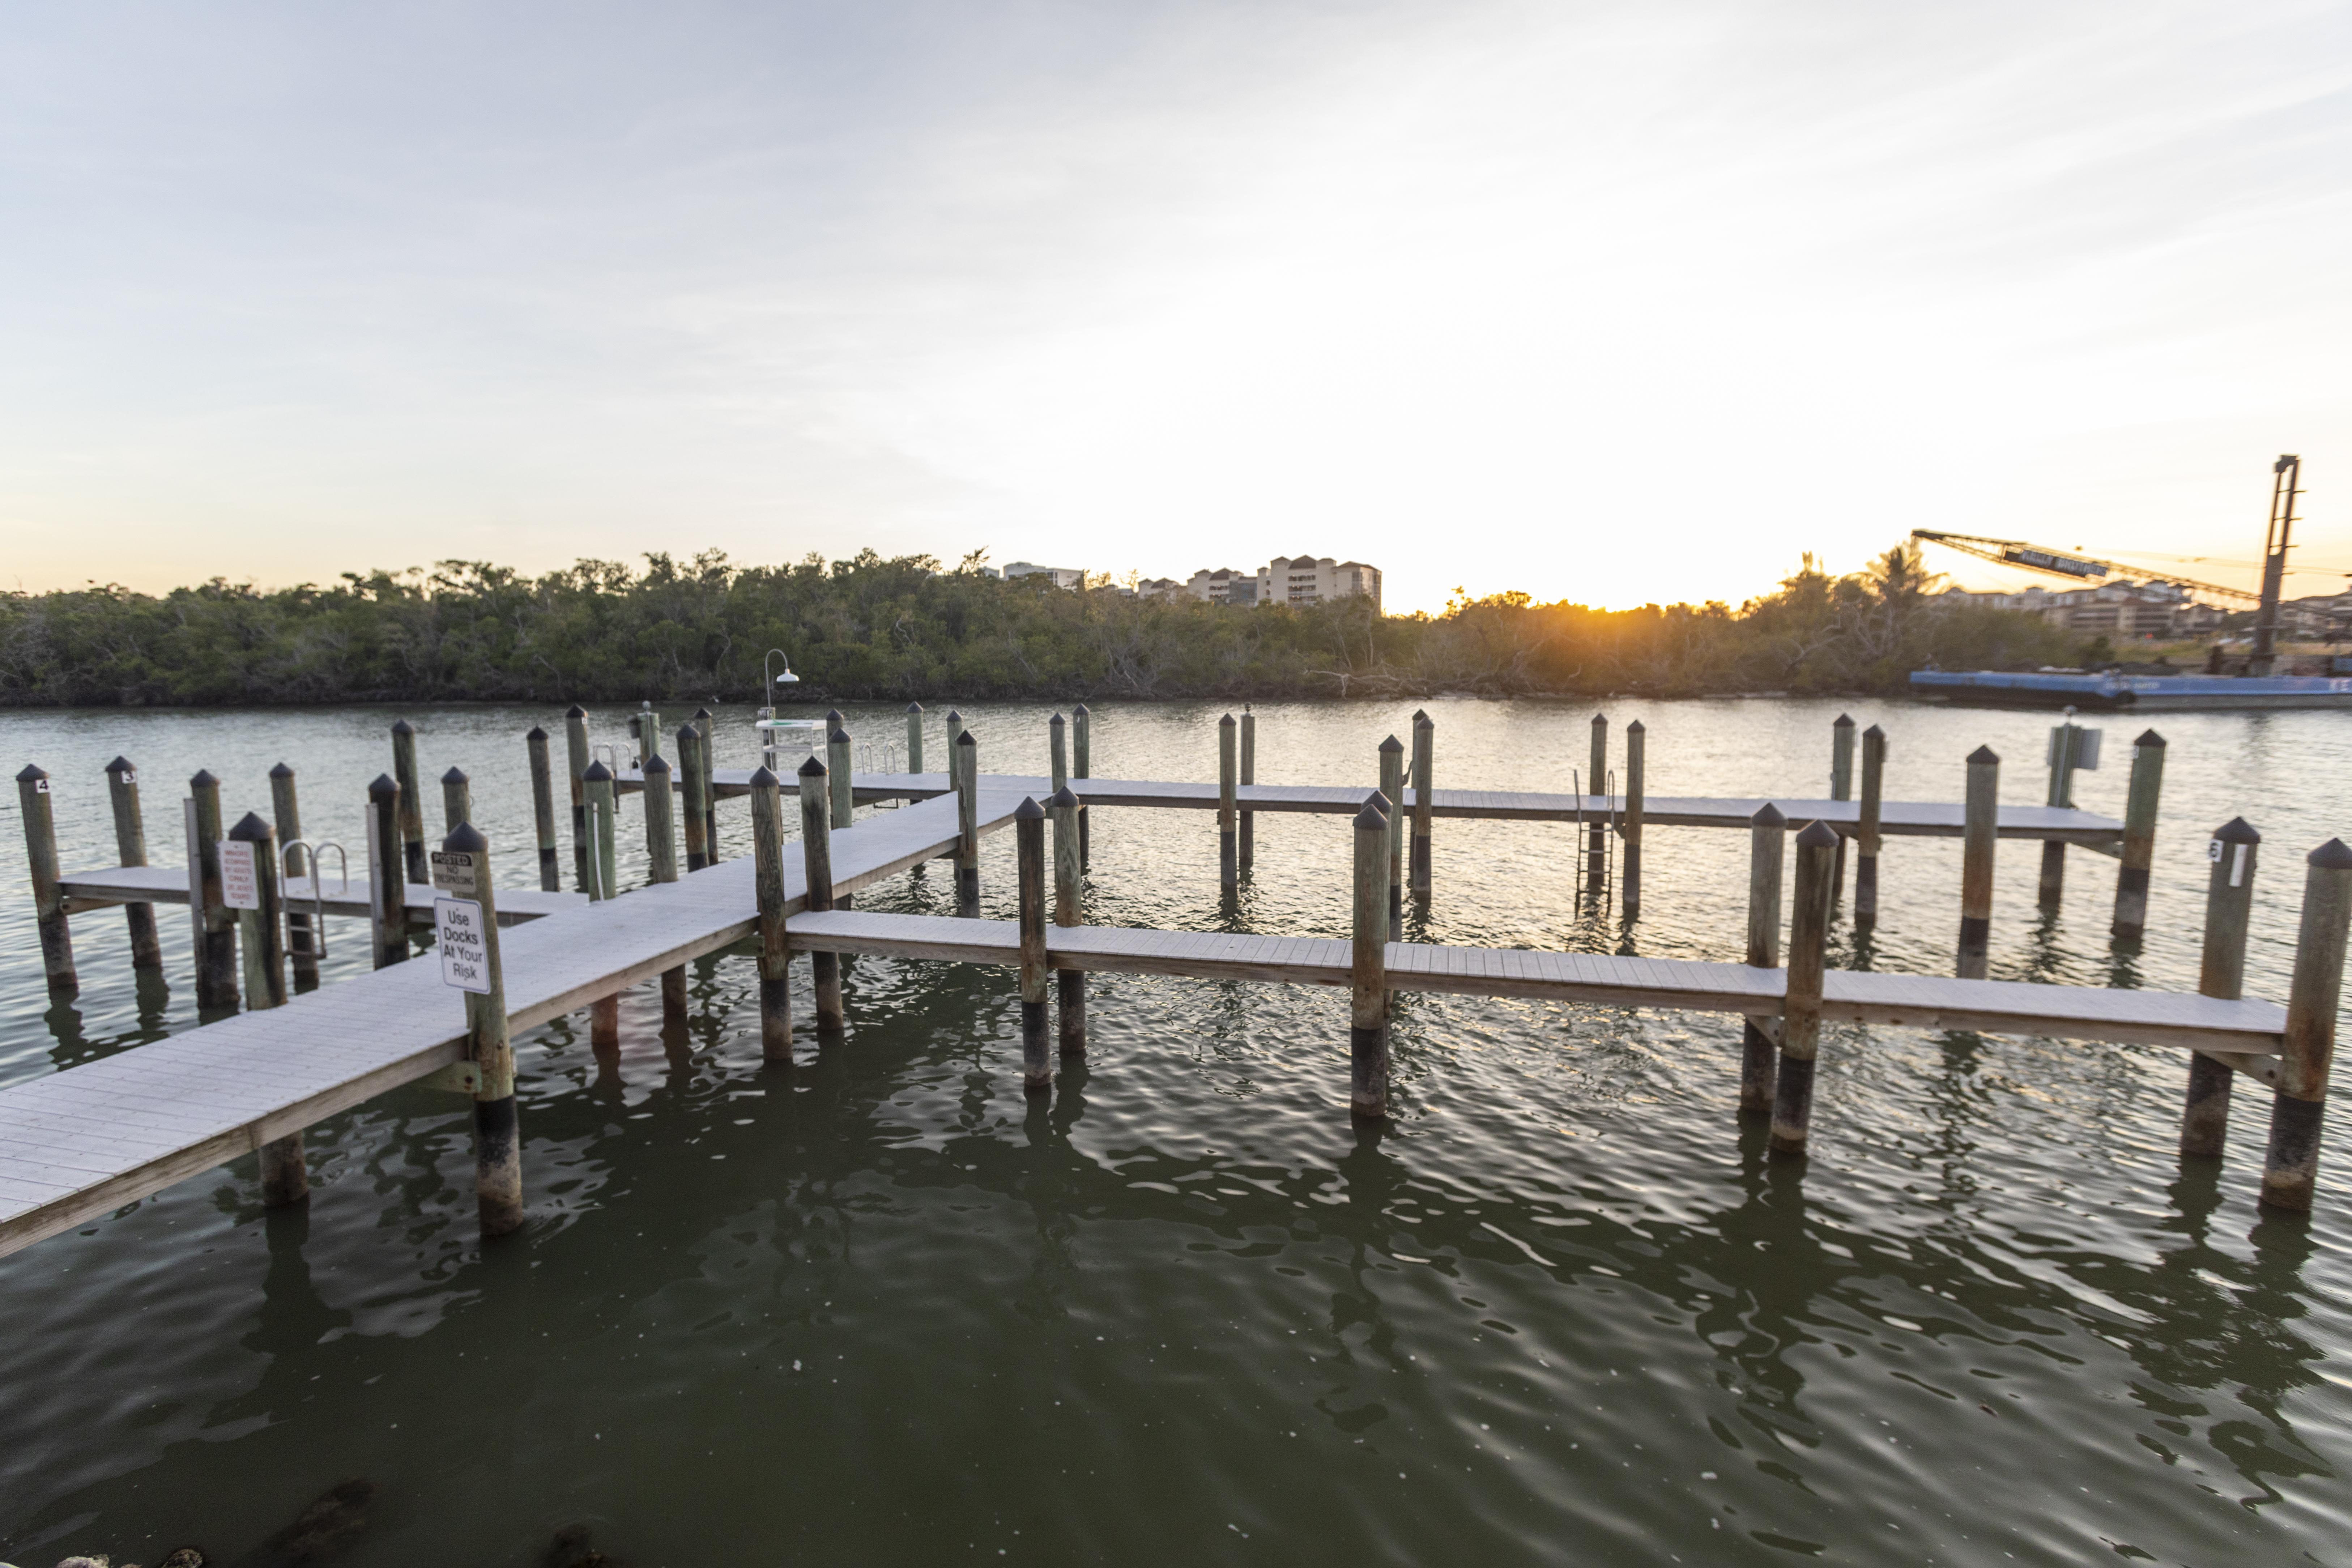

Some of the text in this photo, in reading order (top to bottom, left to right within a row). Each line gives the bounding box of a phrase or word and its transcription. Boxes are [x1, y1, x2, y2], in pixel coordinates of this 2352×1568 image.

[125, 771, 133, 781] 3
[39, 780, 49, 790] 4
[2210, 843, 2219, 857] 6
[434, 854, 469, 865] POSTED
[434, 874, 473, 886] TRESPASSING
[448, 910, 469, 926] Use
[444, 927, 478, 945] Docks
[444, 944, 482, 962] At Your
[453, 963, 477, 979] Risk
